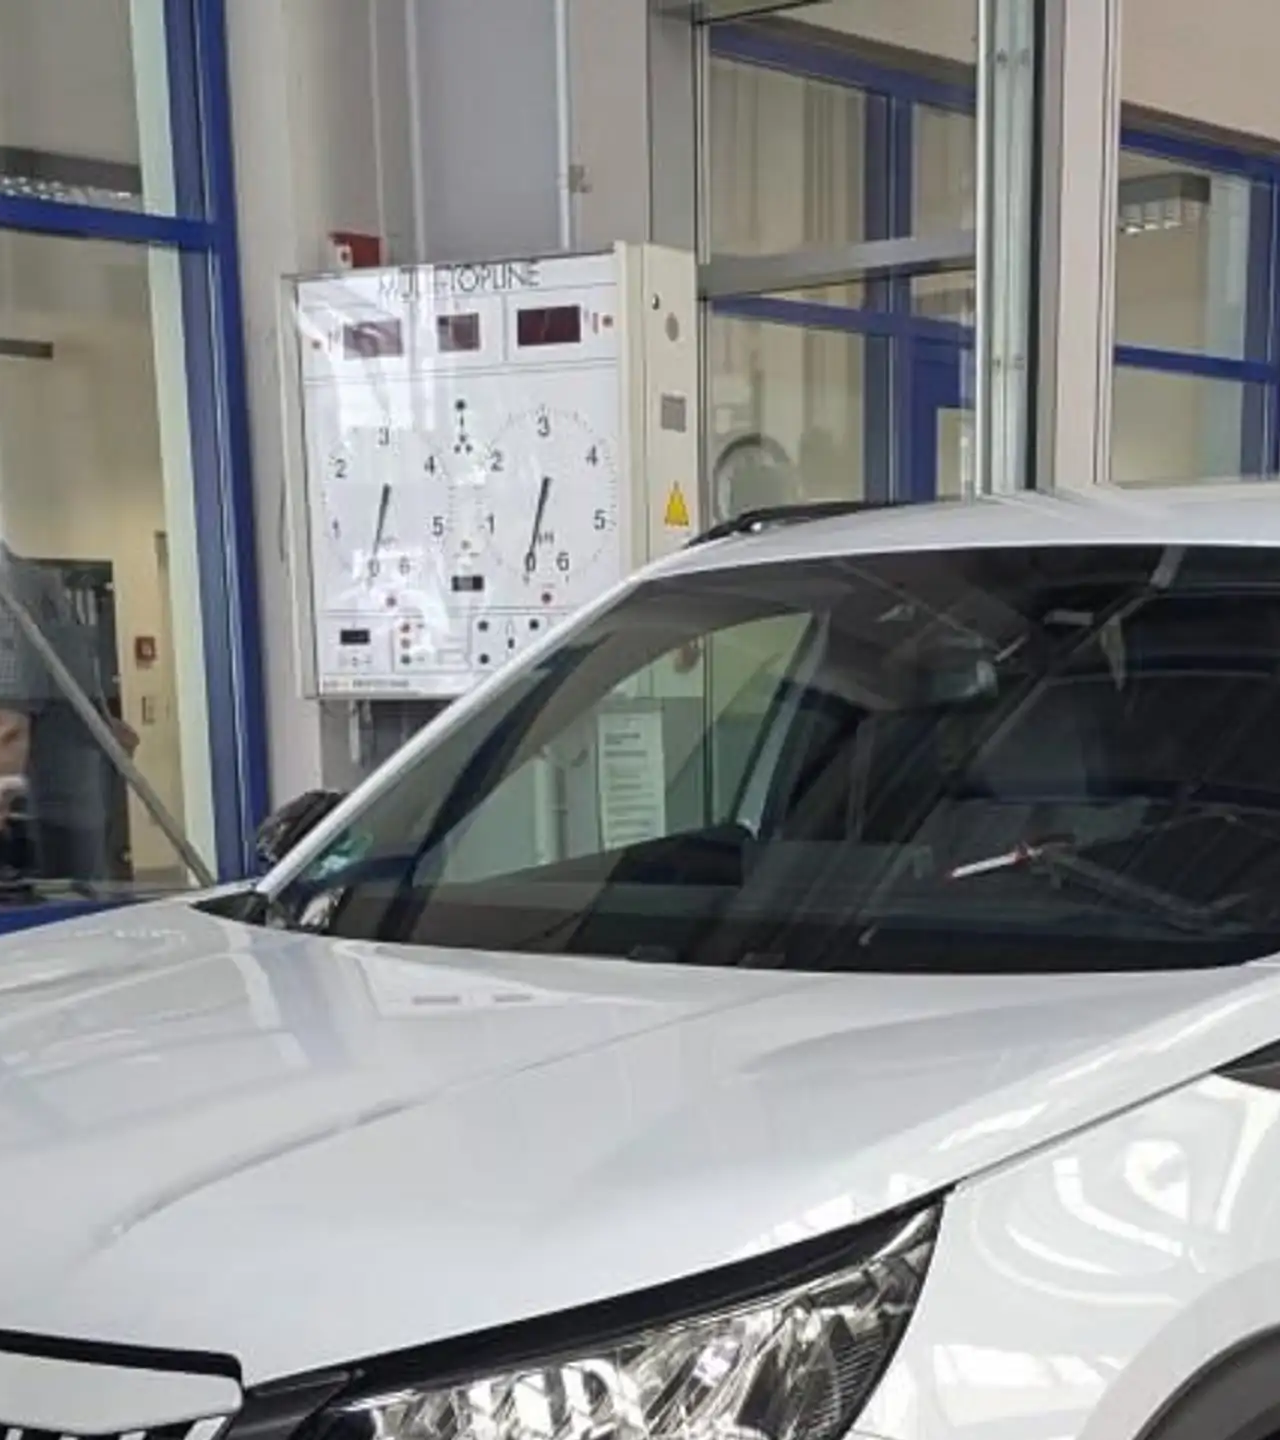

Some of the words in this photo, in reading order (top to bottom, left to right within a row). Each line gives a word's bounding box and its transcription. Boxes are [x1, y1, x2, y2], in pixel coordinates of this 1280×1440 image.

[536, 415, 550, 438] 3
[423, 455, 436, 475] 4
[490, 450, 504, 472] 2
[585, 444, 599, 467] 4
[334, 457, 348, 479] 2
[431, 515, 444, 537] 5
[486, 512, 495, 535] 1
[593, 508, 608, 531] 5
[399, 555, 411, 576] 6
[556, 551, 570, 572] 6
